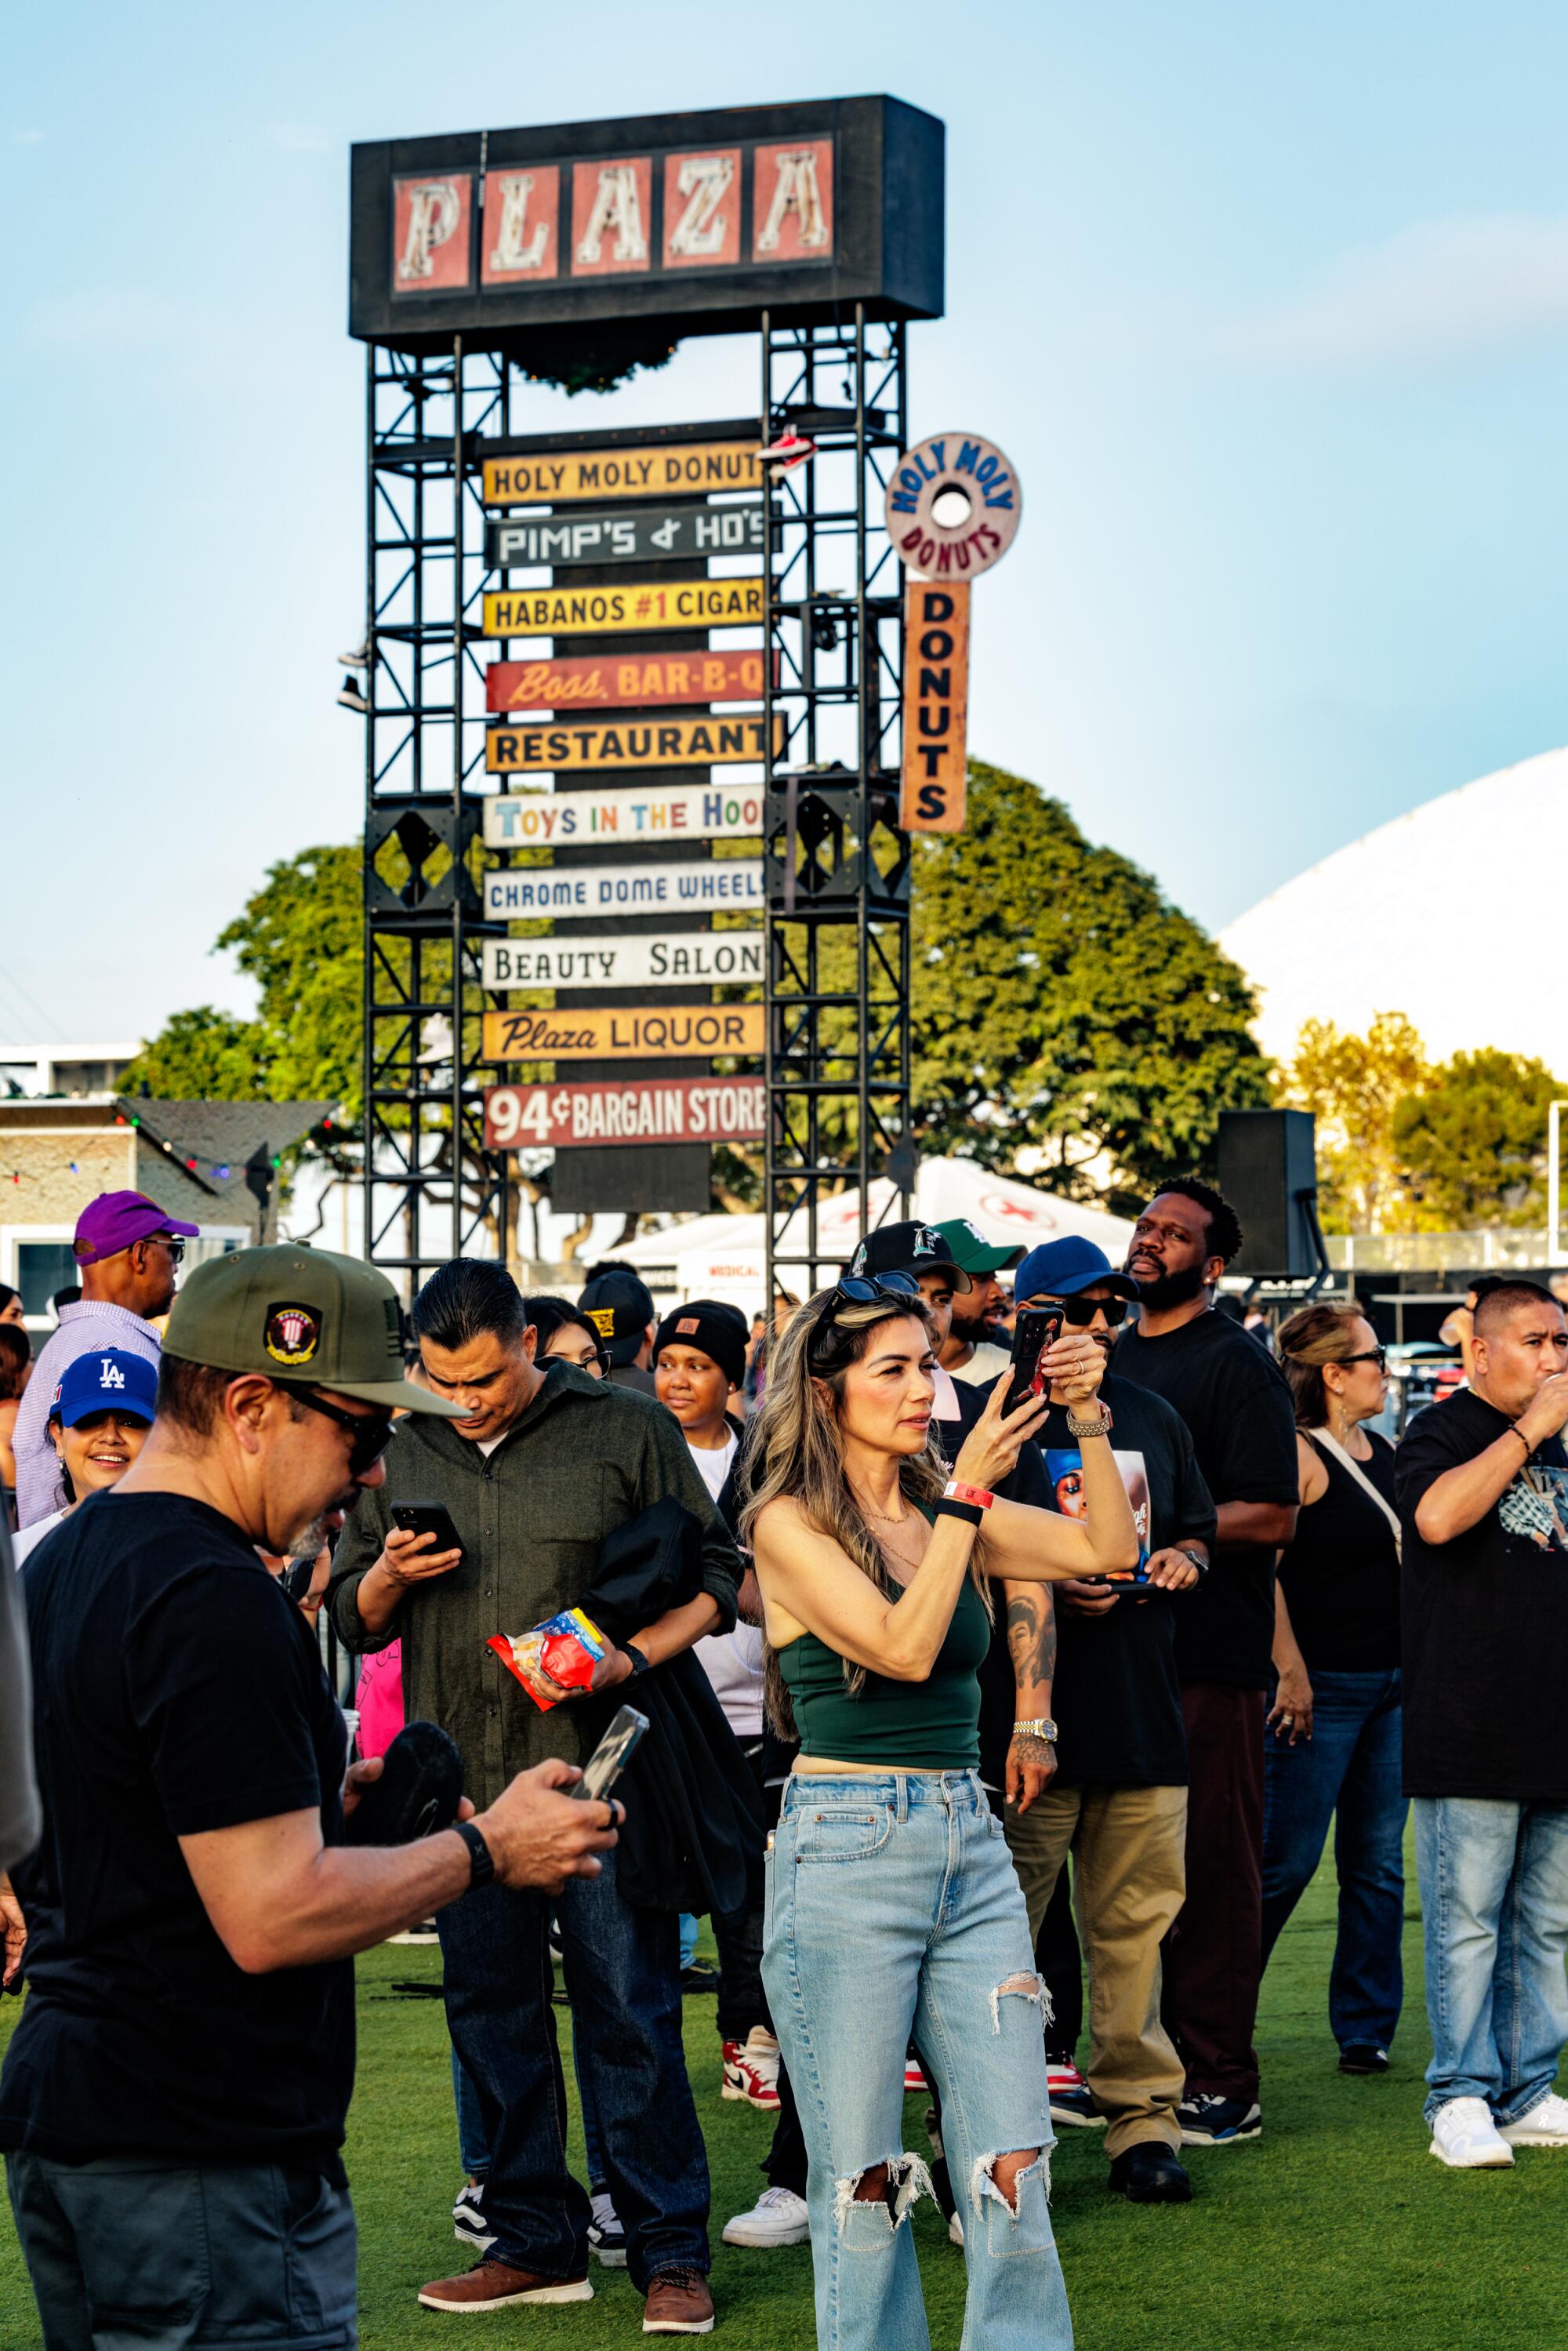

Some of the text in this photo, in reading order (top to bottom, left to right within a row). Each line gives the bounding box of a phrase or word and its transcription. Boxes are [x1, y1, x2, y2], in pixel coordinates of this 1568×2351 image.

[398, 150, 829, 280] PLAZA
[495, 465, 566, 494] HOLY
[579, 459, 654, 489] MOLY
[891, 440, 1014, 514] HOLY MOLY
[499, 508, 764, 562] PIMP'S & HO'S
[901, 523, 1001, 572] DONUTS
[496, 589, 761, 627] HABANOS #1 CIGAR
[617, 657, 764, 698] BAR-B-Q
[916, 592, 954, 819] DONUTS
[496, 723, 766, 763] RESTAURANT
[590, 805, 618, 832] IN
[631, 802, 688, 831] THE
[703, 793, 765, 828] HOO
[491, 872, 766, 907] CHROME DOME WHEEL
[495, 943, 760, 981] BEAUTY SALON
[502, 1016, 746, 1054] Plaza LIQUOR
[488, 1085, 766, 1142] 94¢ BARGAIN STORE
[100, 1358, 125, 1389] LA
